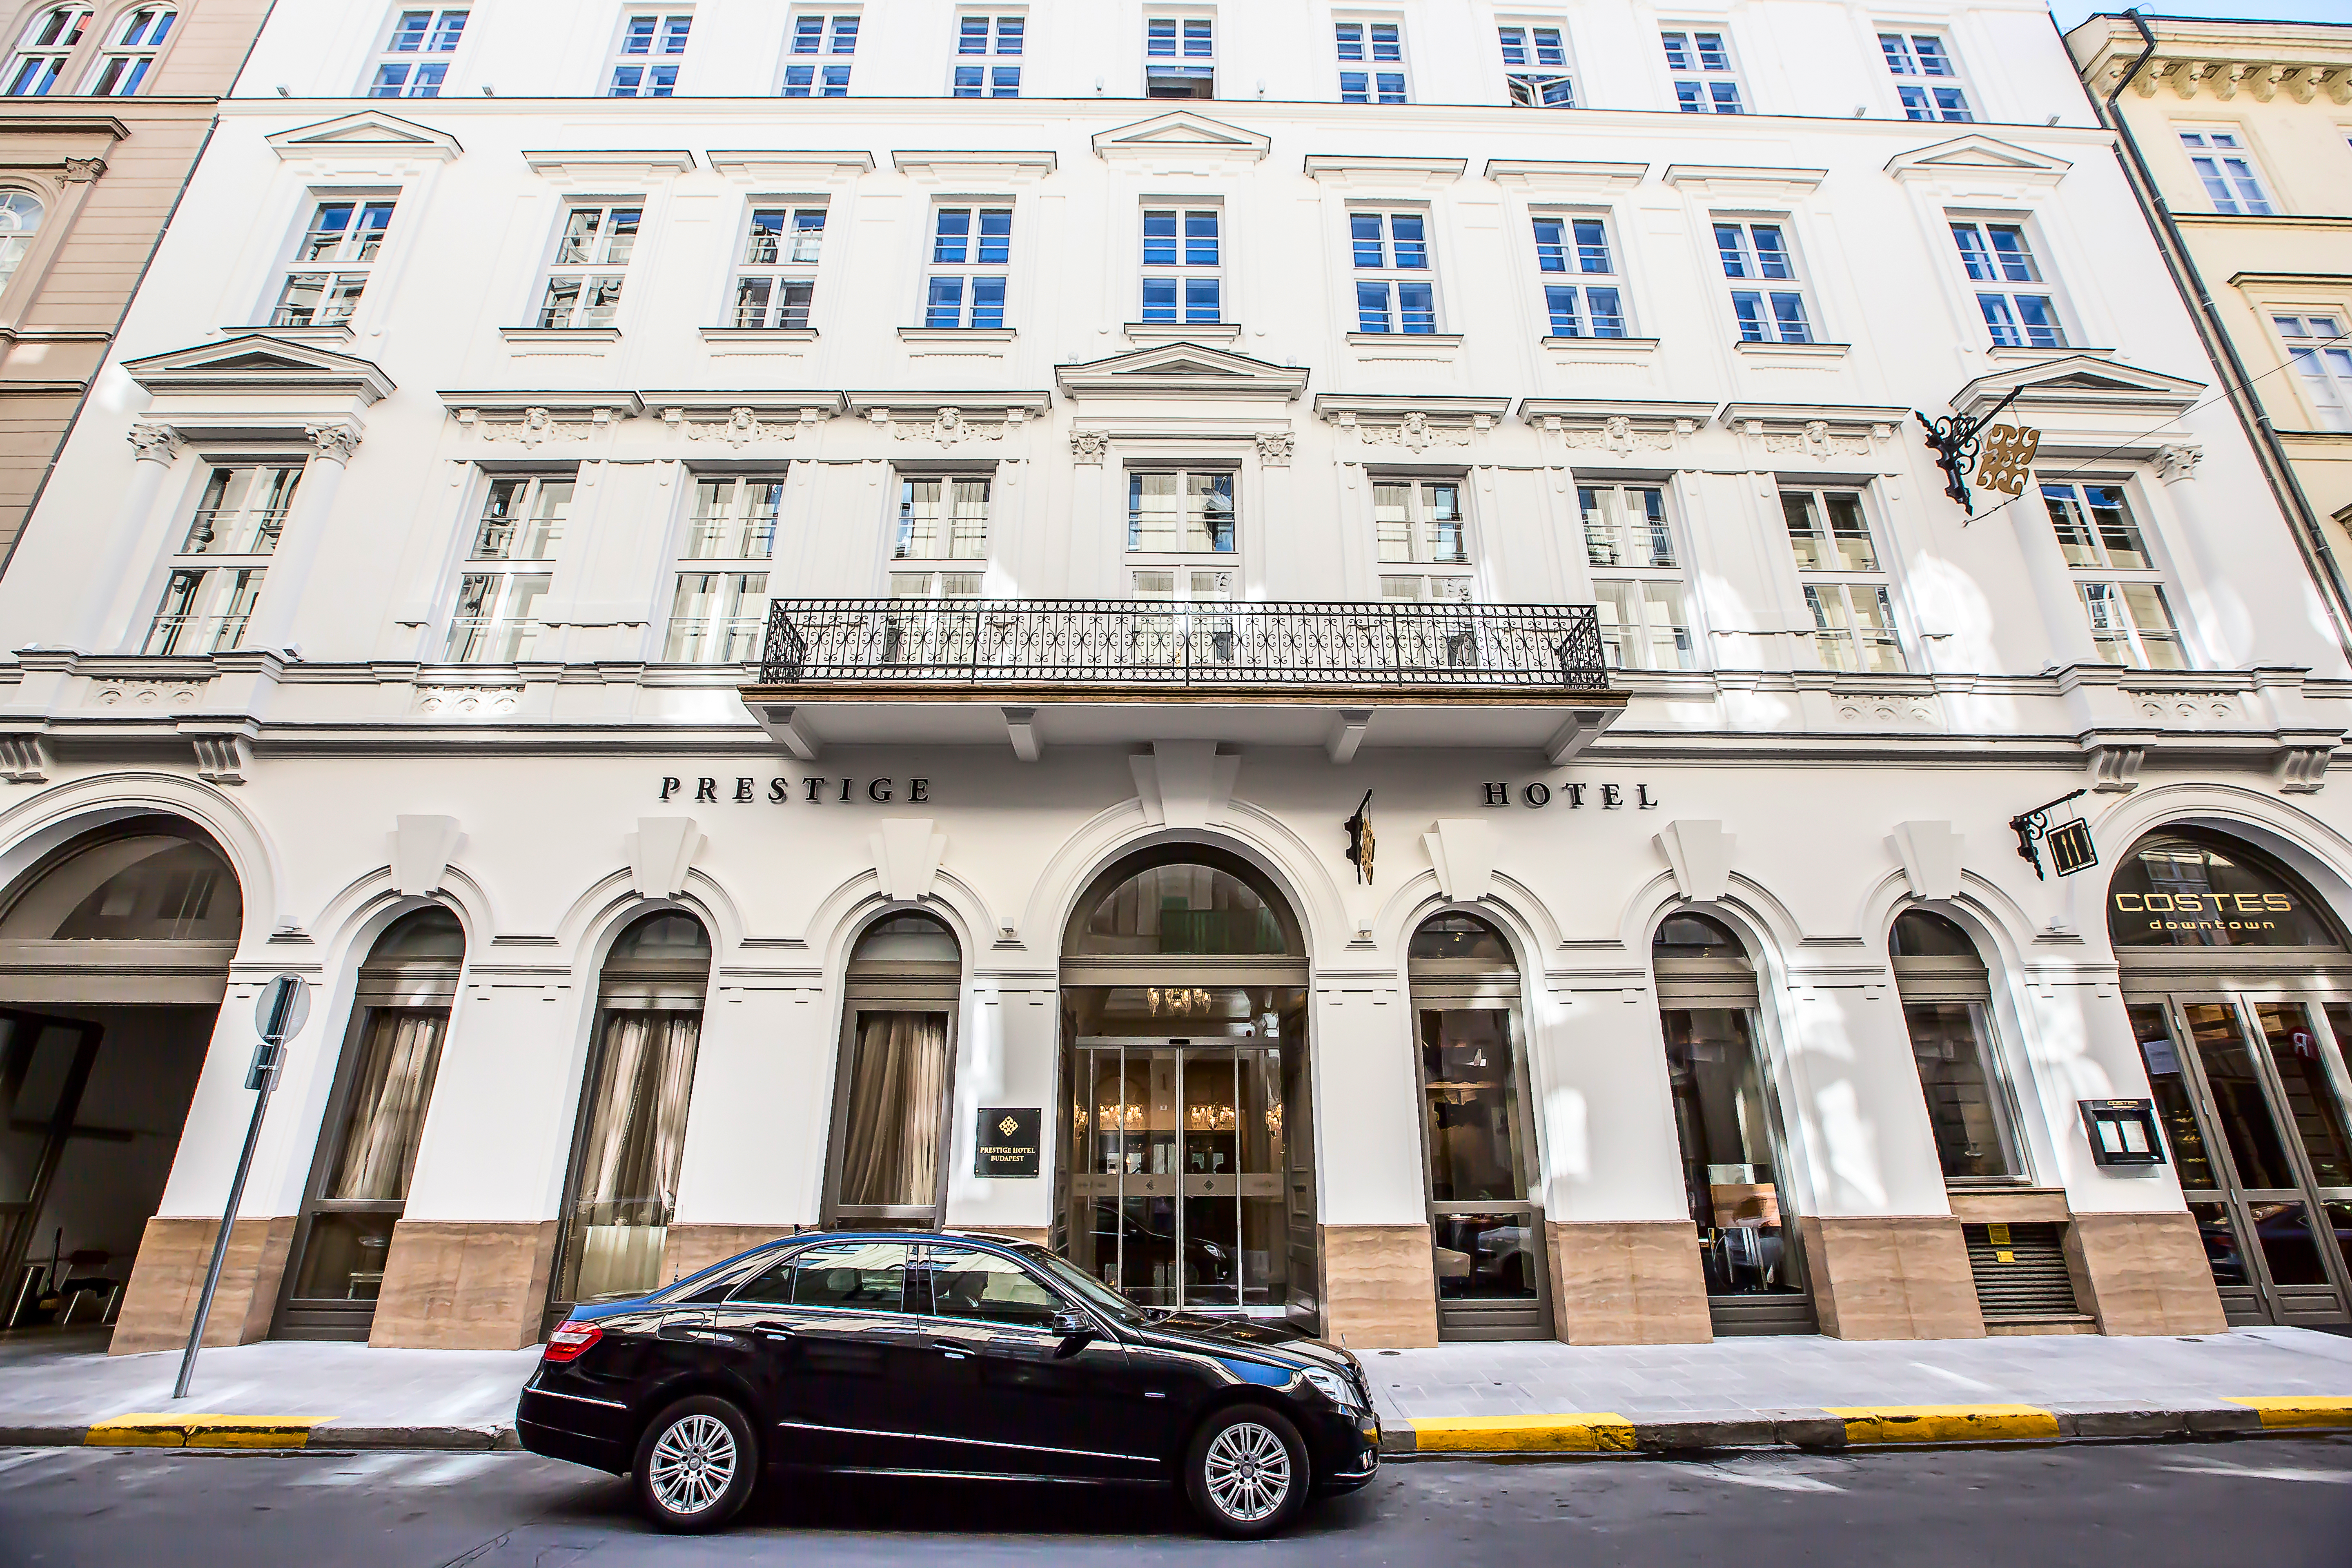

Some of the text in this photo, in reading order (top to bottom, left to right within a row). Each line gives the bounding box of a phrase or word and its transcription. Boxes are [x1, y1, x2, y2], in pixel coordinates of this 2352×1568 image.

[658, 777, 1658, 806] PRESTIGE HOTEL
[2115, 893, 2291, 911] COSTES
[2149, 920, 2275, 929] downtown
